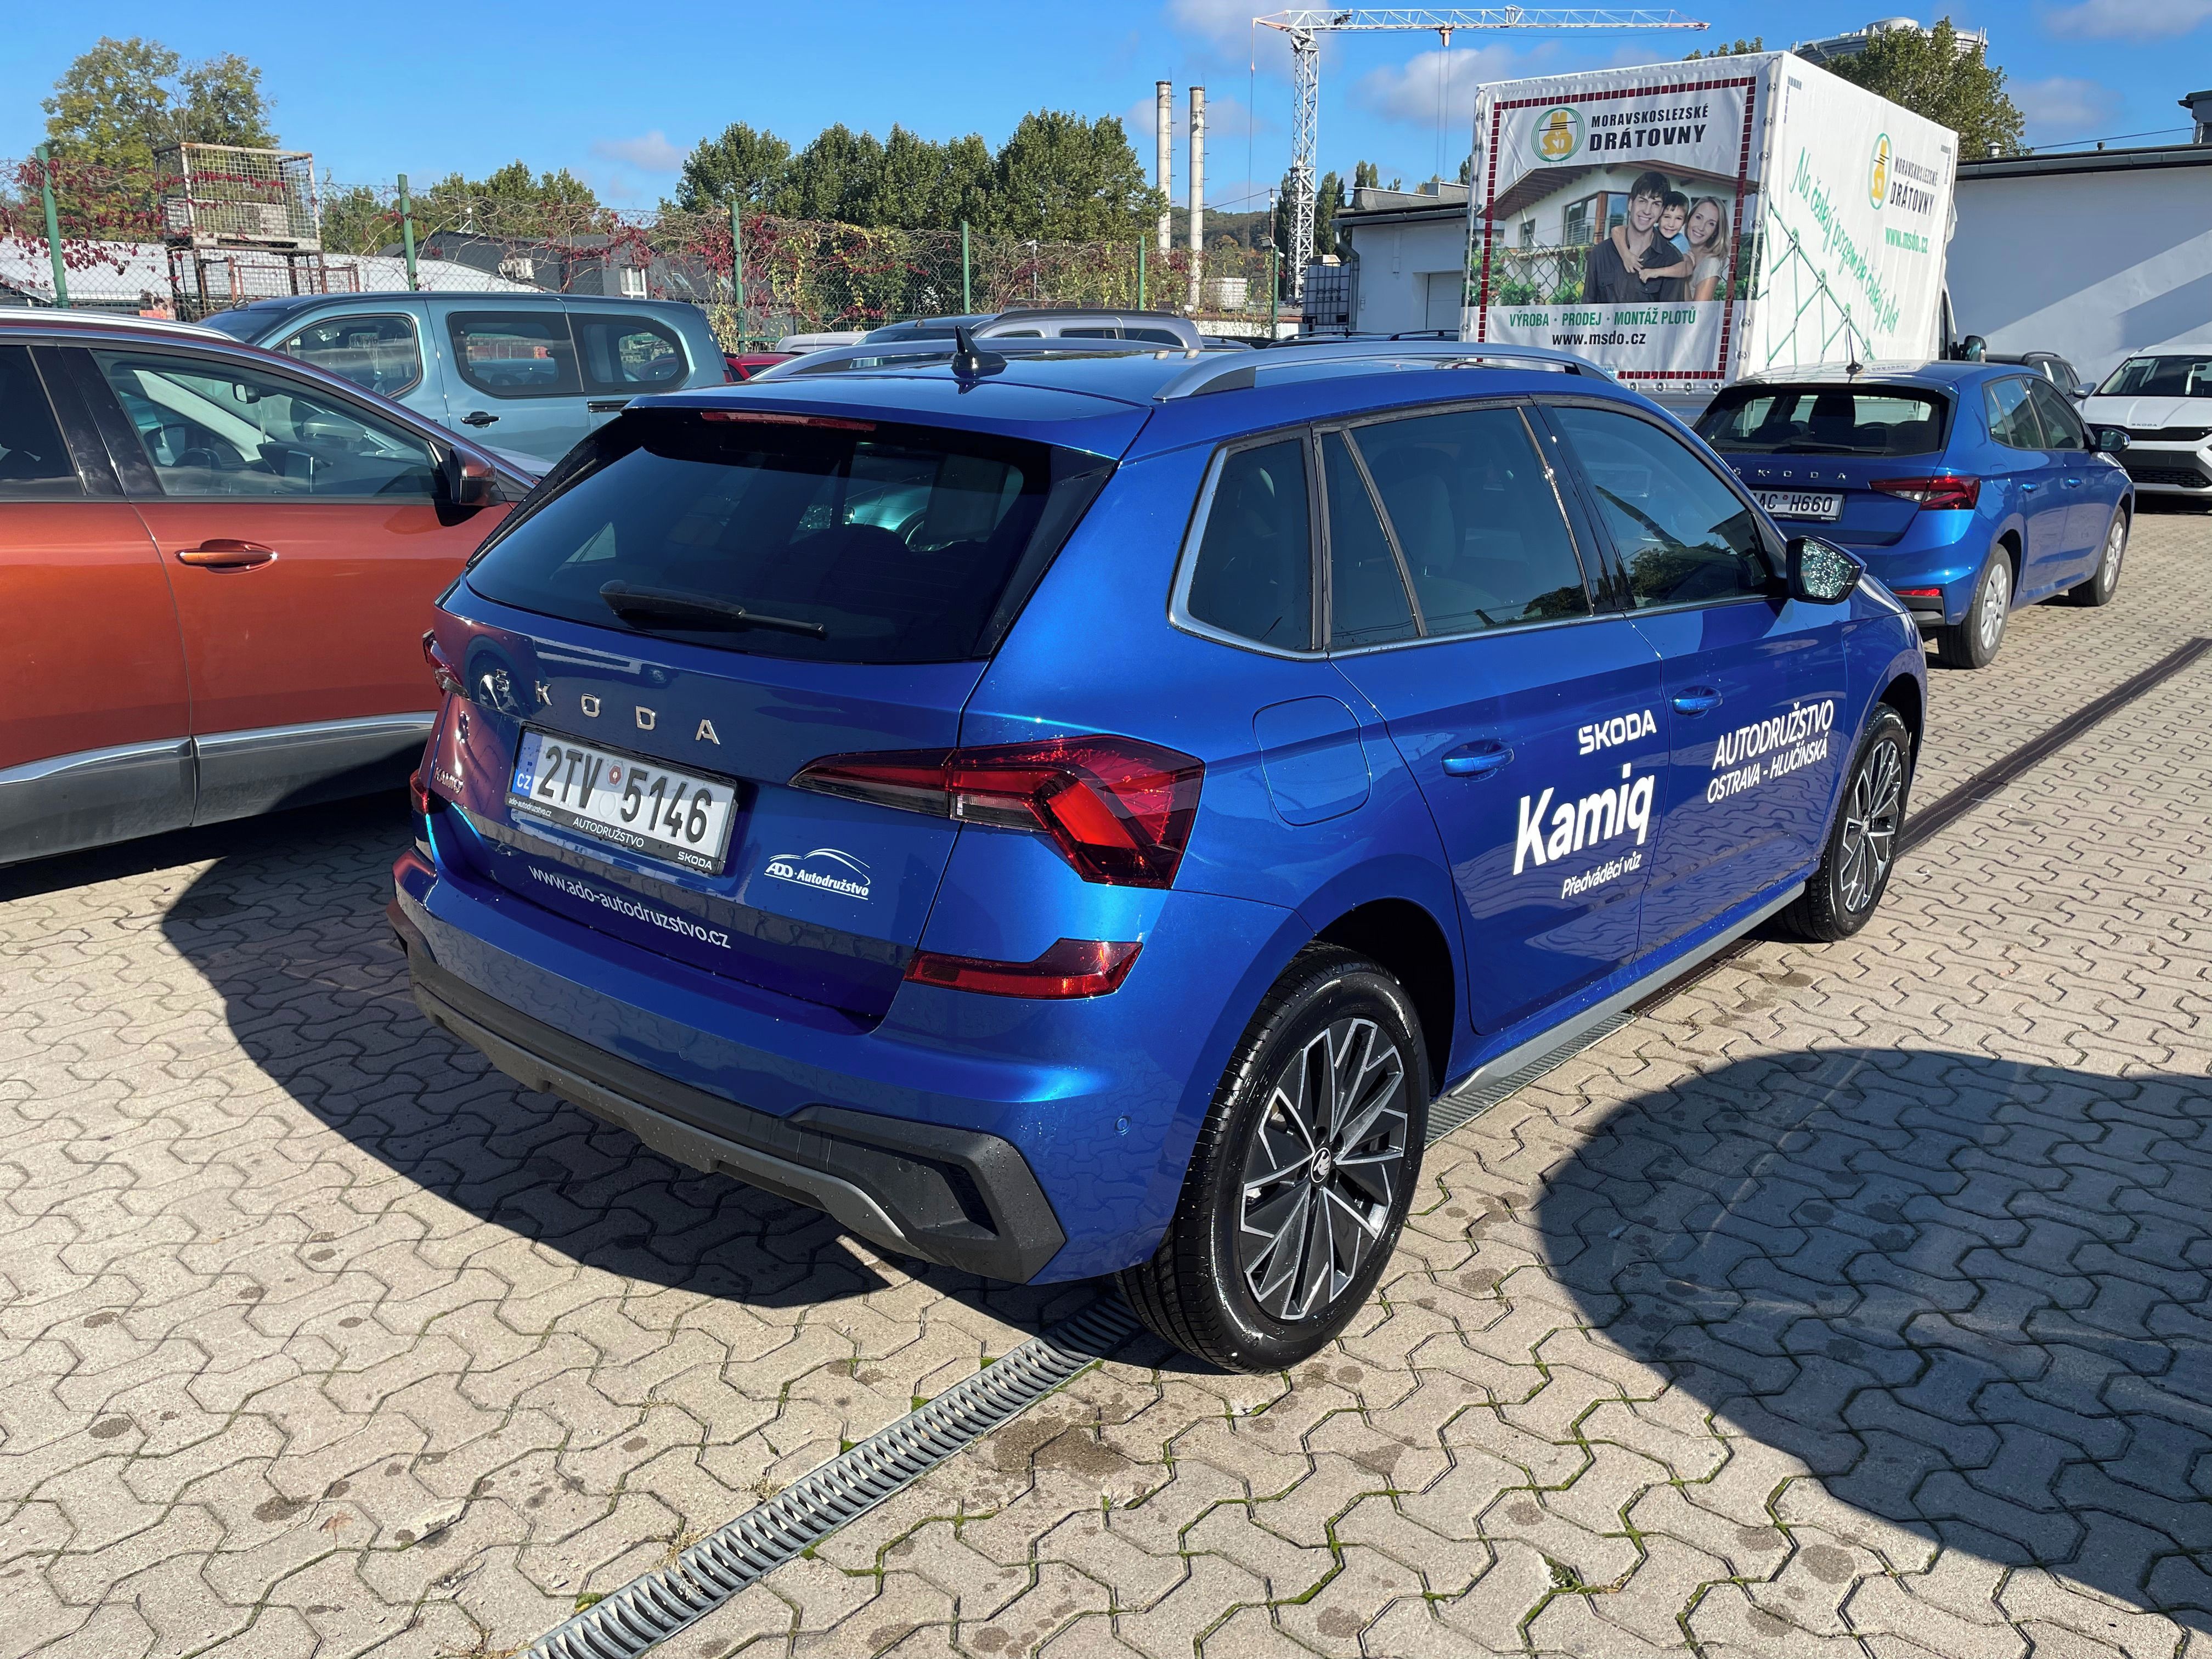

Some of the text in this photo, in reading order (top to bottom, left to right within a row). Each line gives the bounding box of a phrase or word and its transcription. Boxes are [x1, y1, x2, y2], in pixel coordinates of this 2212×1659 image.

[1592, 103, 1709, 127] MORAVSKOSLEZSKÉ
[1589, 124, 1706, 151] DRÁTOVNY
[1894, 156, 1939, 187] MORAVSKOSLEZSKÉ
[1889, 180, 1935, 216] DRÁTOVNY
[1789, 146, 1811, 203] Na
[1810, 176, 1837, 253] český
[1830, 217, 1869, 291] pozemek
[1885, 227, 1928, 254] www.msdo.cz
[1509, 306, 1697, 327] VÝROBA PRODEJ MONTÁŽ PLOTŮ
[1552, 330, 1646, 345] www.msdo.cz
[1753, 493, 1833, 513] AC H660
[1712, 699, 1833, 771] AUTODRUŽSTVO
[1707, 763, 1760, 803] OSTRAVA
[1770, 731, 1829, 779] HLUČÍNSKÁ
[509, 797, 552, 817] ado-autodruzstvo.cz
[517, 745, 712, 843] CZ 2TV 5146
[572, 817, 644, 848] AUTODRUŽSTVO
[1513, 763, 1655, 875] Kamiq
[1561, 851, 1642, 900] Předváděcí vůz
[528, 865, 731, 949] www.ado-autodruzstvo.cz
